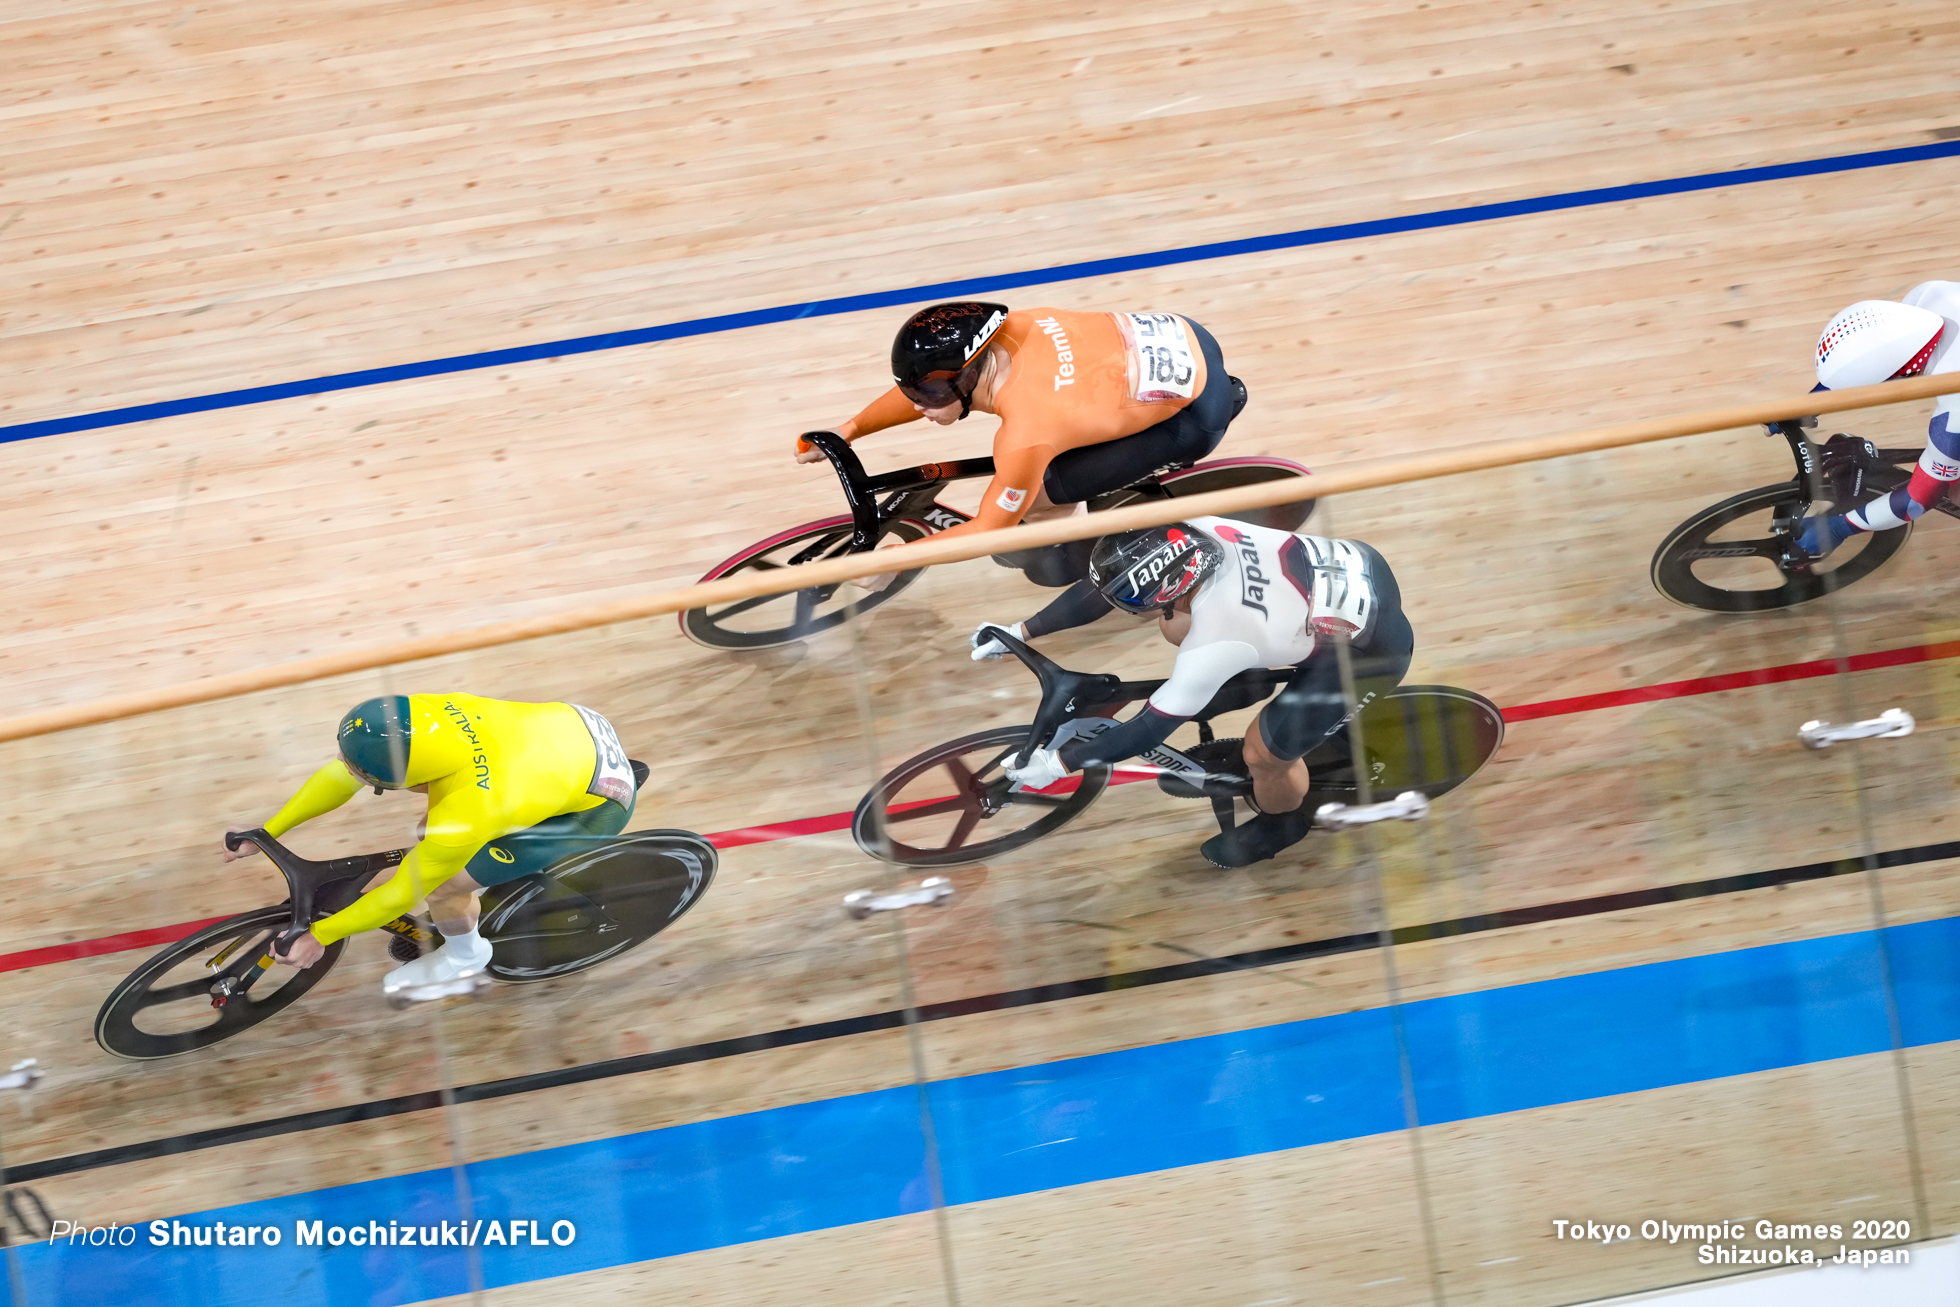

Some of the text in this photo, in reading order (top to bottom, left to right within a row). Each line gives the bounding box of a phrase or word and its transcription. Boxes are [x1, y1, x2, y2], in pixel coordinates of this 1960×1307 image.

[963, 310, 1007, 361] LAZER
[1035, 316, 1076, 392] TeamNL
[1797, 441, 1814, 475] LOTUS
[887, 491, 910, 512] KOGA
[923, 508, 967, 530] KO
[1126, 540, 1190, 599] Japan
[1240, 532, 1271, 623] Japan
